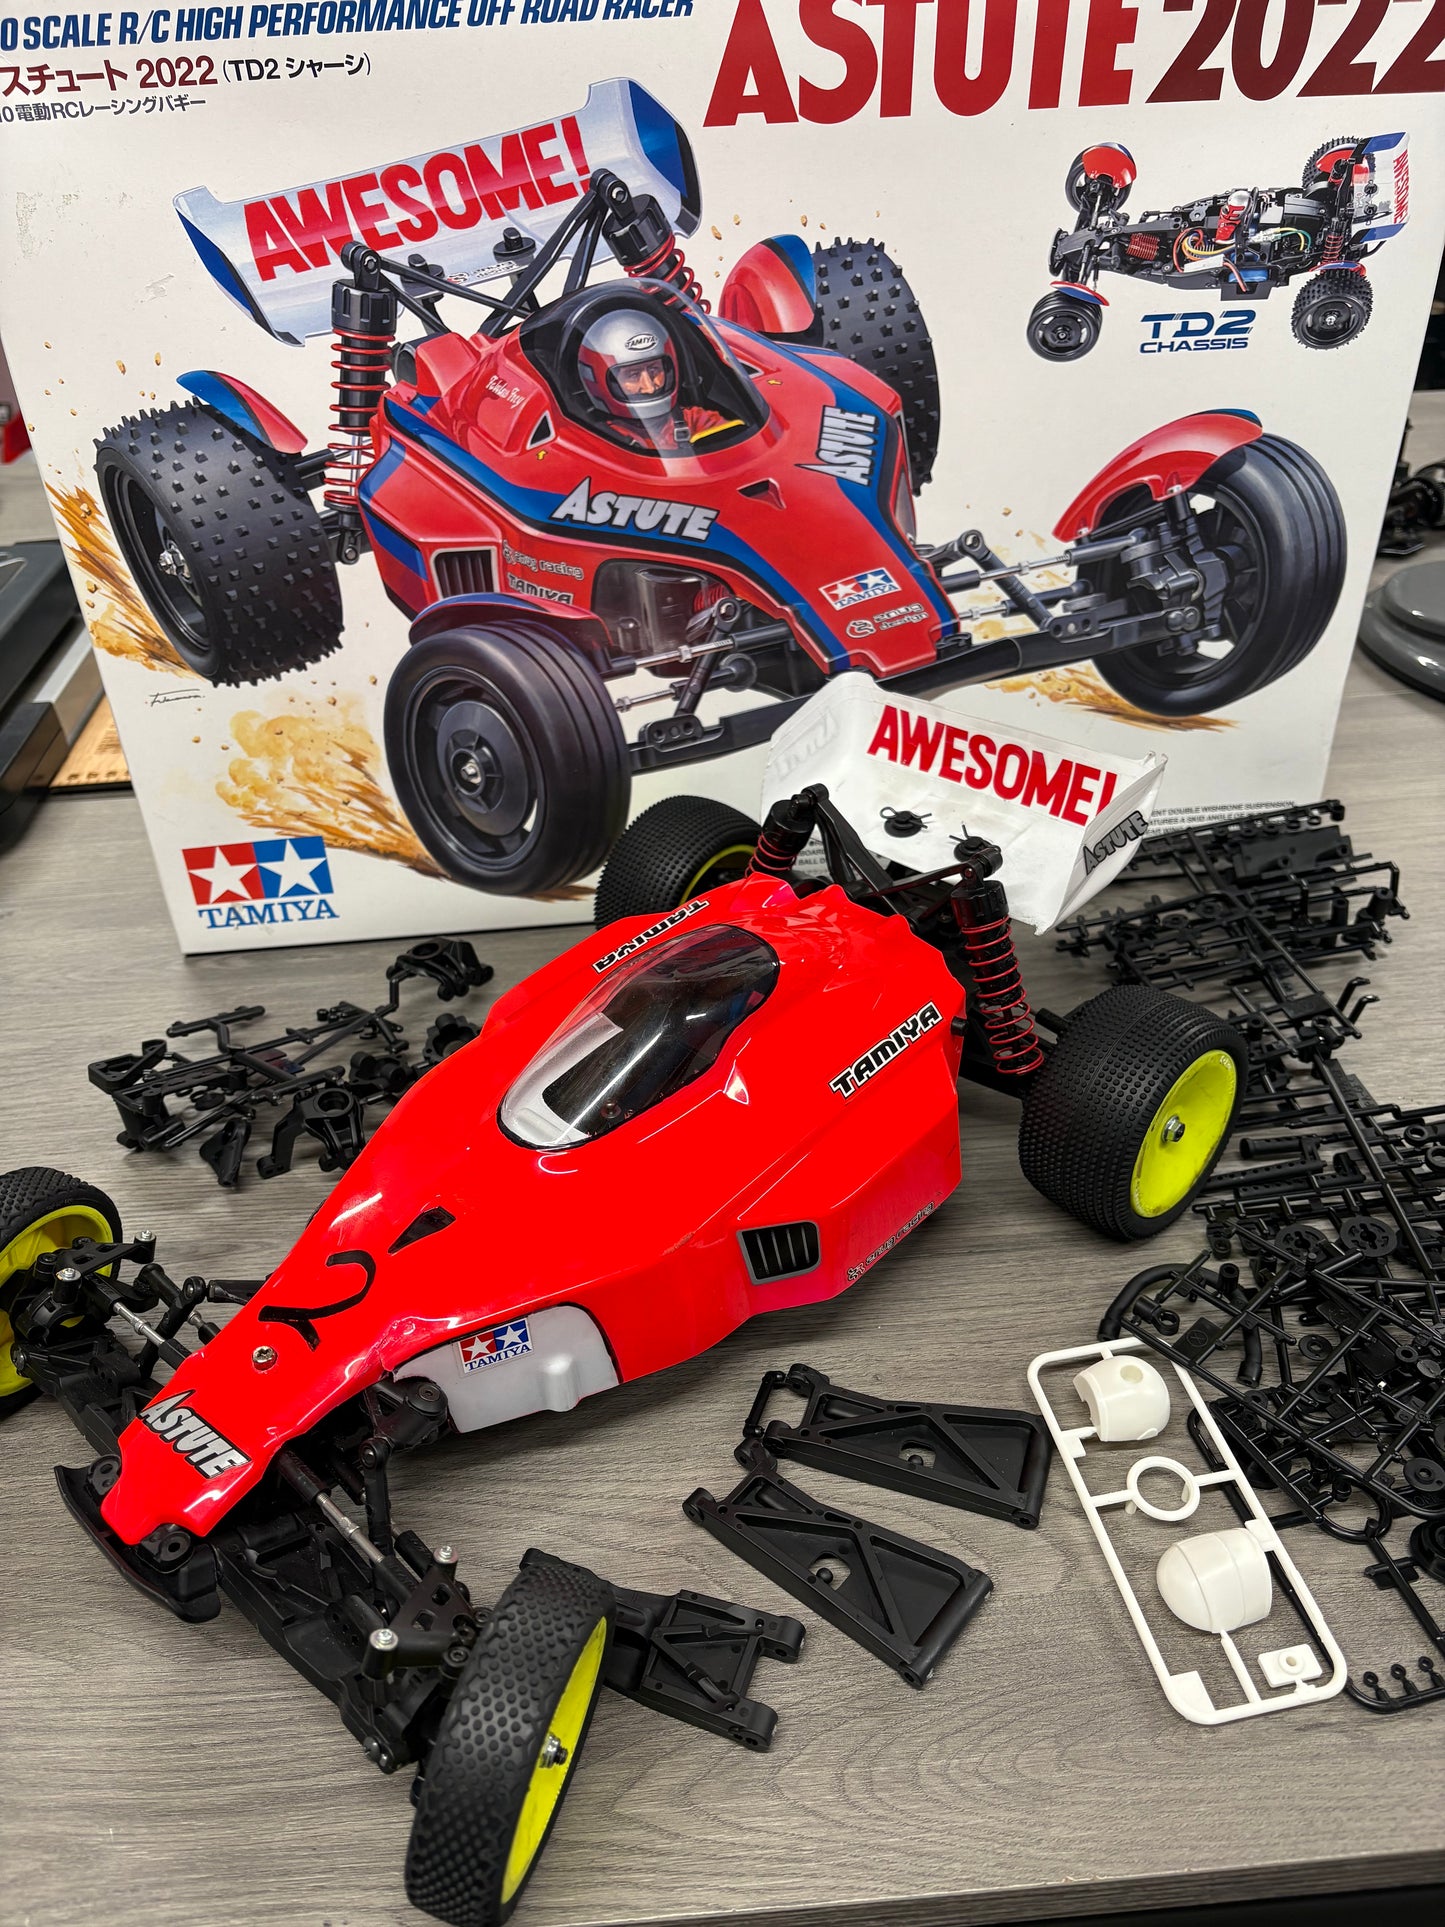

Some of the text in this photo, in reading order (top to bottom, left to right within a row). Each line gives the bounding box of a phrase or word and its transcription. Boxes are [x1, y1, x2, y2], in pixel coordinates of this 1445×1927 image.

[23, 12, 113, 50] SCALE
[118, 9, 171, 46] R/C
[175, 5, 244, 42] HIGH
[248, 0, 463, 38] PERFORMANCE
[466, 0, 515, 27] OFF
[520, 0, 599, 25] ROAD
[602, 0, 694, 20] RACER
[0, 59, 128, 97] スチュート
[136, 55, 218, 88] 2022
[703, 0, 1139, 127] ASTUTE
[243, 115, 592, 281] AWESOME!
[625, 335, 656, 348] TAMIYA
[1140, 309, 1256, 339] TD2
[1140, 337, 1249, 354] CHASSIS
[794, 405, 879, 487] ASTUTE
[548, 476, 720, 543] ASTUTE
[508, 572, 575, 605] TAMIYA
[539, 559, 585, 580] racing
[834, 584, 899, 609] TAMIYA
[879, 611, 929, 631] design
[866, 704, 1118, 826] AWESOME!
[1083, 811, 1148, 875] ASTUTE
[198, 898, 340, 929] TAMIYA
[592, 899, 710, 973] TAMIYA
[828, 1000, 944, 1099] TAMIYA
[464, 1343, 532, 1372] TAMIYA
[136, 1388, 252, 1480] ASTUTE
